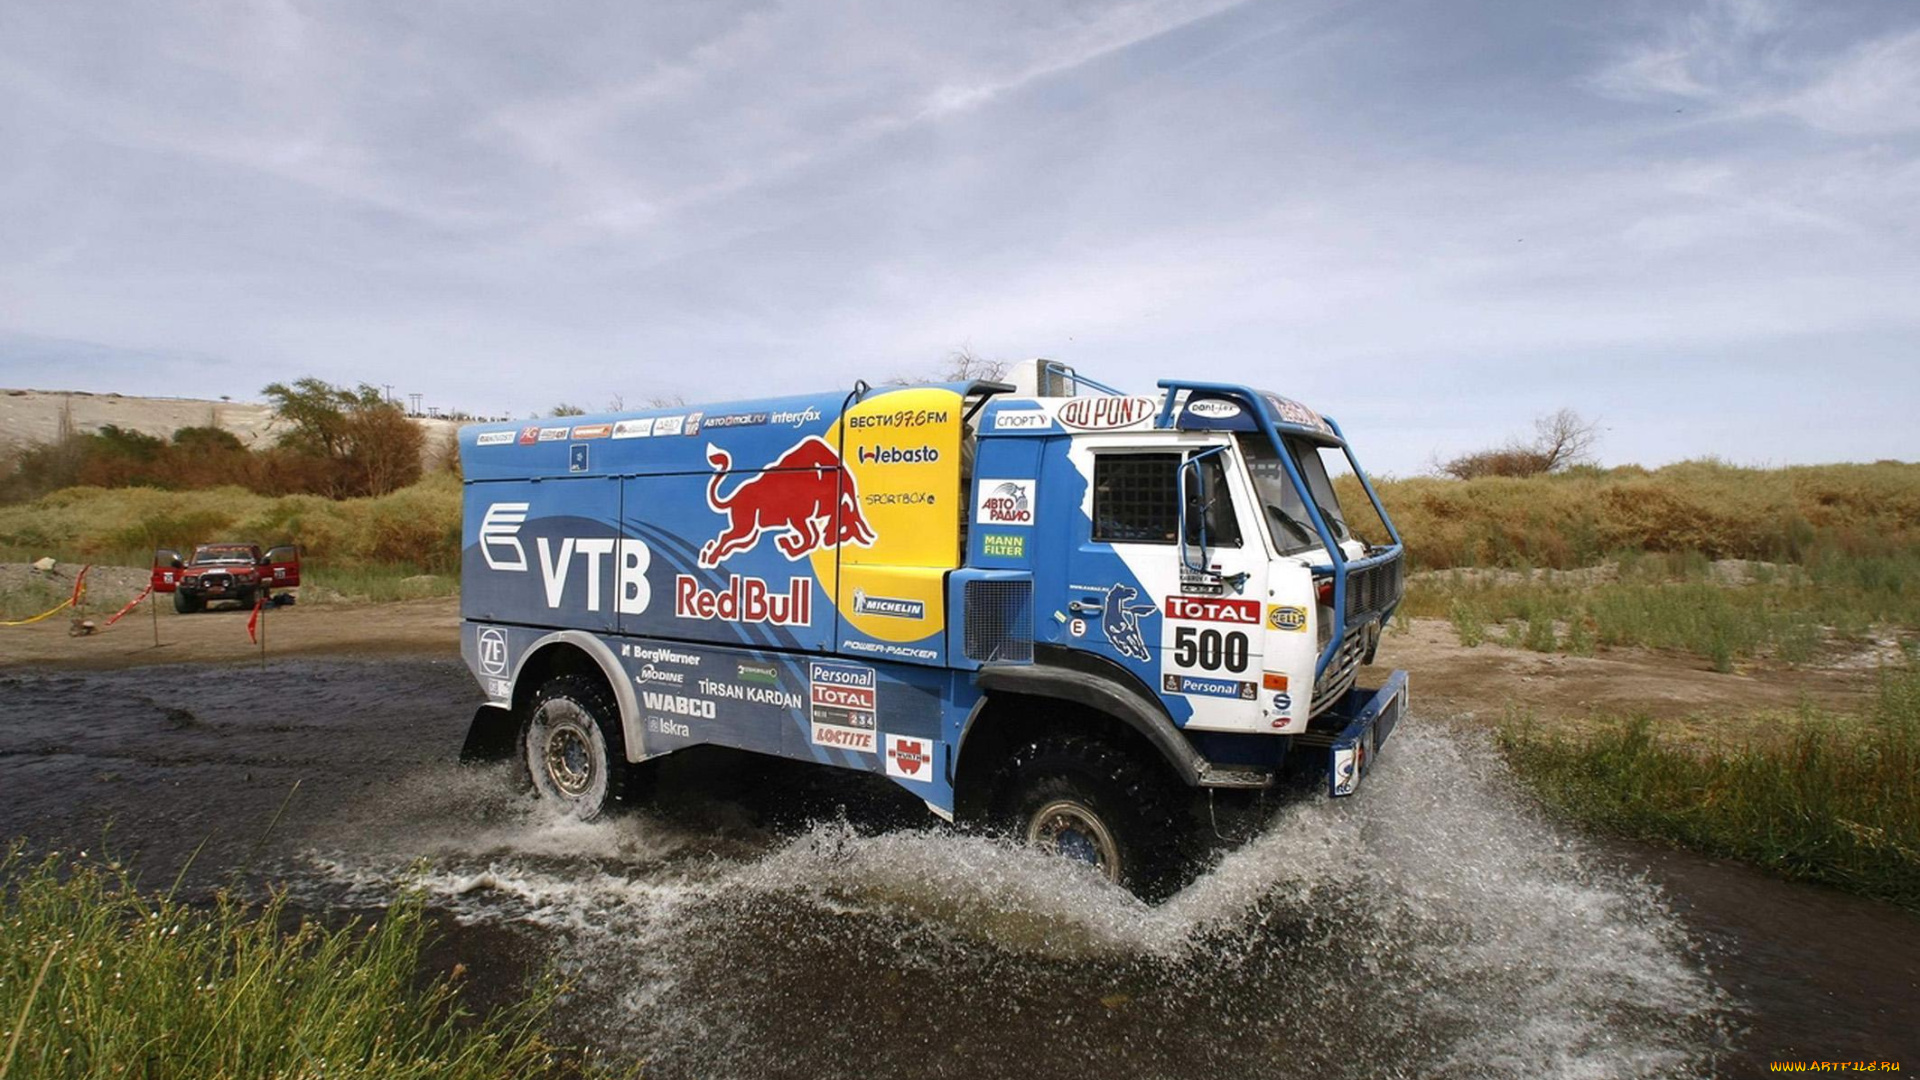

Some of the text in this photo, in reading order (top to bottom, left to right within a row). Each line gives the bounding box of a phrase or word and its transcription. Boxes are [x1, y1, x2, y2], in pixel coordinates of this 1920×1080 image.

[771, 406, 821, 428] interfax
[1065, 397, 1148, 426] DU PONT
[859, 445, 938, 464] Webasto
[982, 497, 1014, 510] АВТО
[990, 509, 1031, 522] РАДИО
[984, 535, 1023, 546] MANN
[984, 545, 1023, 556] FILTER
[536, 537, 651, 615] VTB
[866, 602, 922, 615] MICHELIN
[1168, 598, 1256, 621] TOTAL
[482, 638, 506, 666] ZF
[634, 645, 701, 666] BorgWarner
[843, 640, 938, 659] POWER-PACKER
[1174, 626, 1249, 674] 500
[641, 668, 684, 684] MODINE
[813, 666, 872, 686] Personal
[814, 686, 872, 707] TOTAL
[1183, 679, 1237, 694] Personal
[643, 691, 716, 719] WABCO
[747, 687, 802, 709] KARDAN
[659, 719, 690, 737] Iskra
[816, 728, 872, 748] LOCTITE
